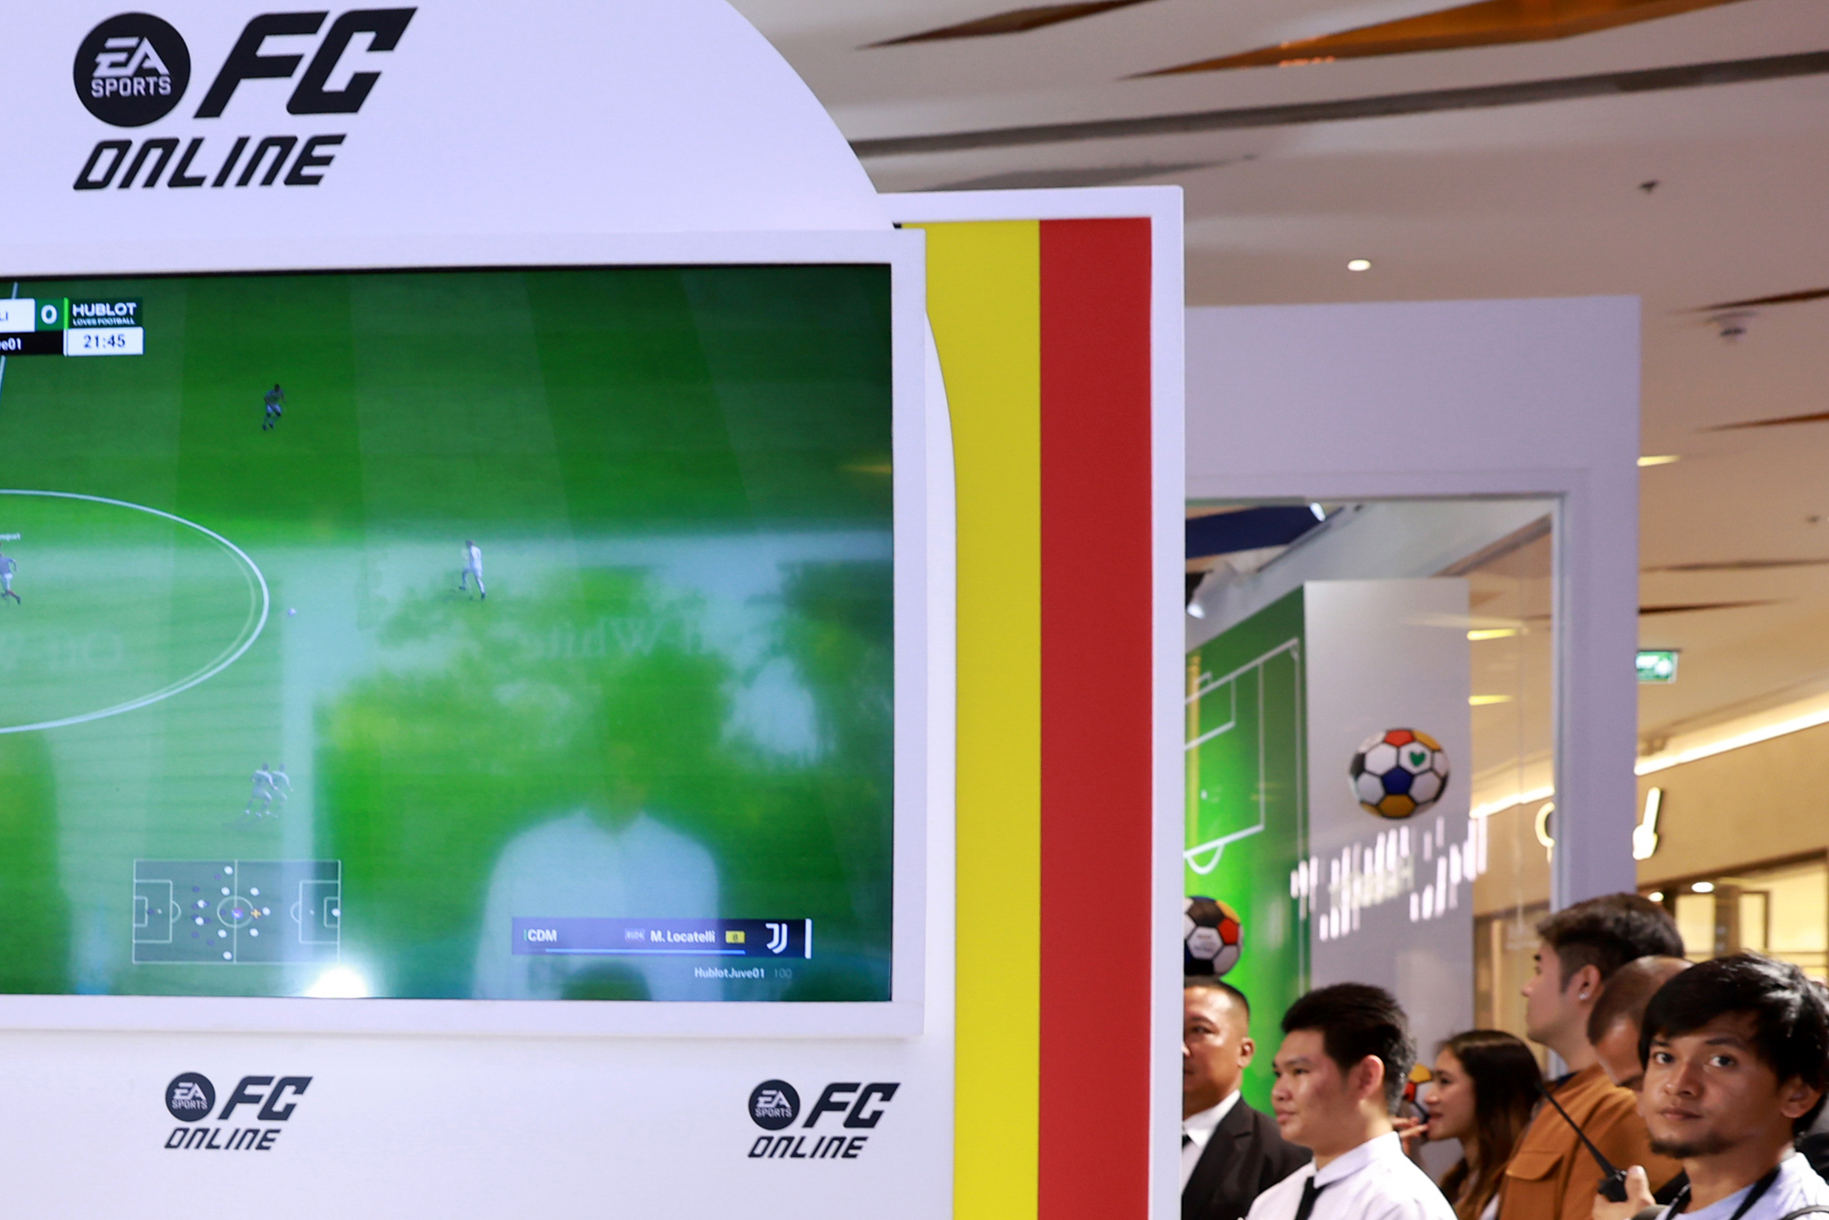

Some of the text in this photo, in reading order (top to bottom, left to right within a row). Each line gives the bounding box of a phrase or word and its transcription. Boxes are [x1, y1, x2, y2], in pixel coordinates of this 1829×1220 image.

[92, 36, 170, 77] EA
[193, 7, 418, 119] FC
[90, 76, 172, 98] SPORTS
[73, 133, 347, 190] ONLINE
[41, 305, 58, 325] 0
[72, 302, 138, 317] HUBLOT
[72, 316, 135, 326] LOVES FOOTBALL
[83, 334, 126, 349] 21:45
[527, 929, 558, 942] CDM
[650, 930, 666, 943] M.
[667, 930, 716, 943] Locatelli
[694, 966, 765, 979] HublotJuve01
[172, 1082, 207, 1100] EA
[217, 1075, 313, 1121] FC
[756, 1089, 792, 1108] EA
[171, 1100, 208, 1110] SPORTS
[755, 1107, 793, 1118] SPORTS
[801, 1082, 901, 1128] FC
[164, 1127, 282, 1150] ONLINE
[747, 1135, 869, 1159] ONLINE
